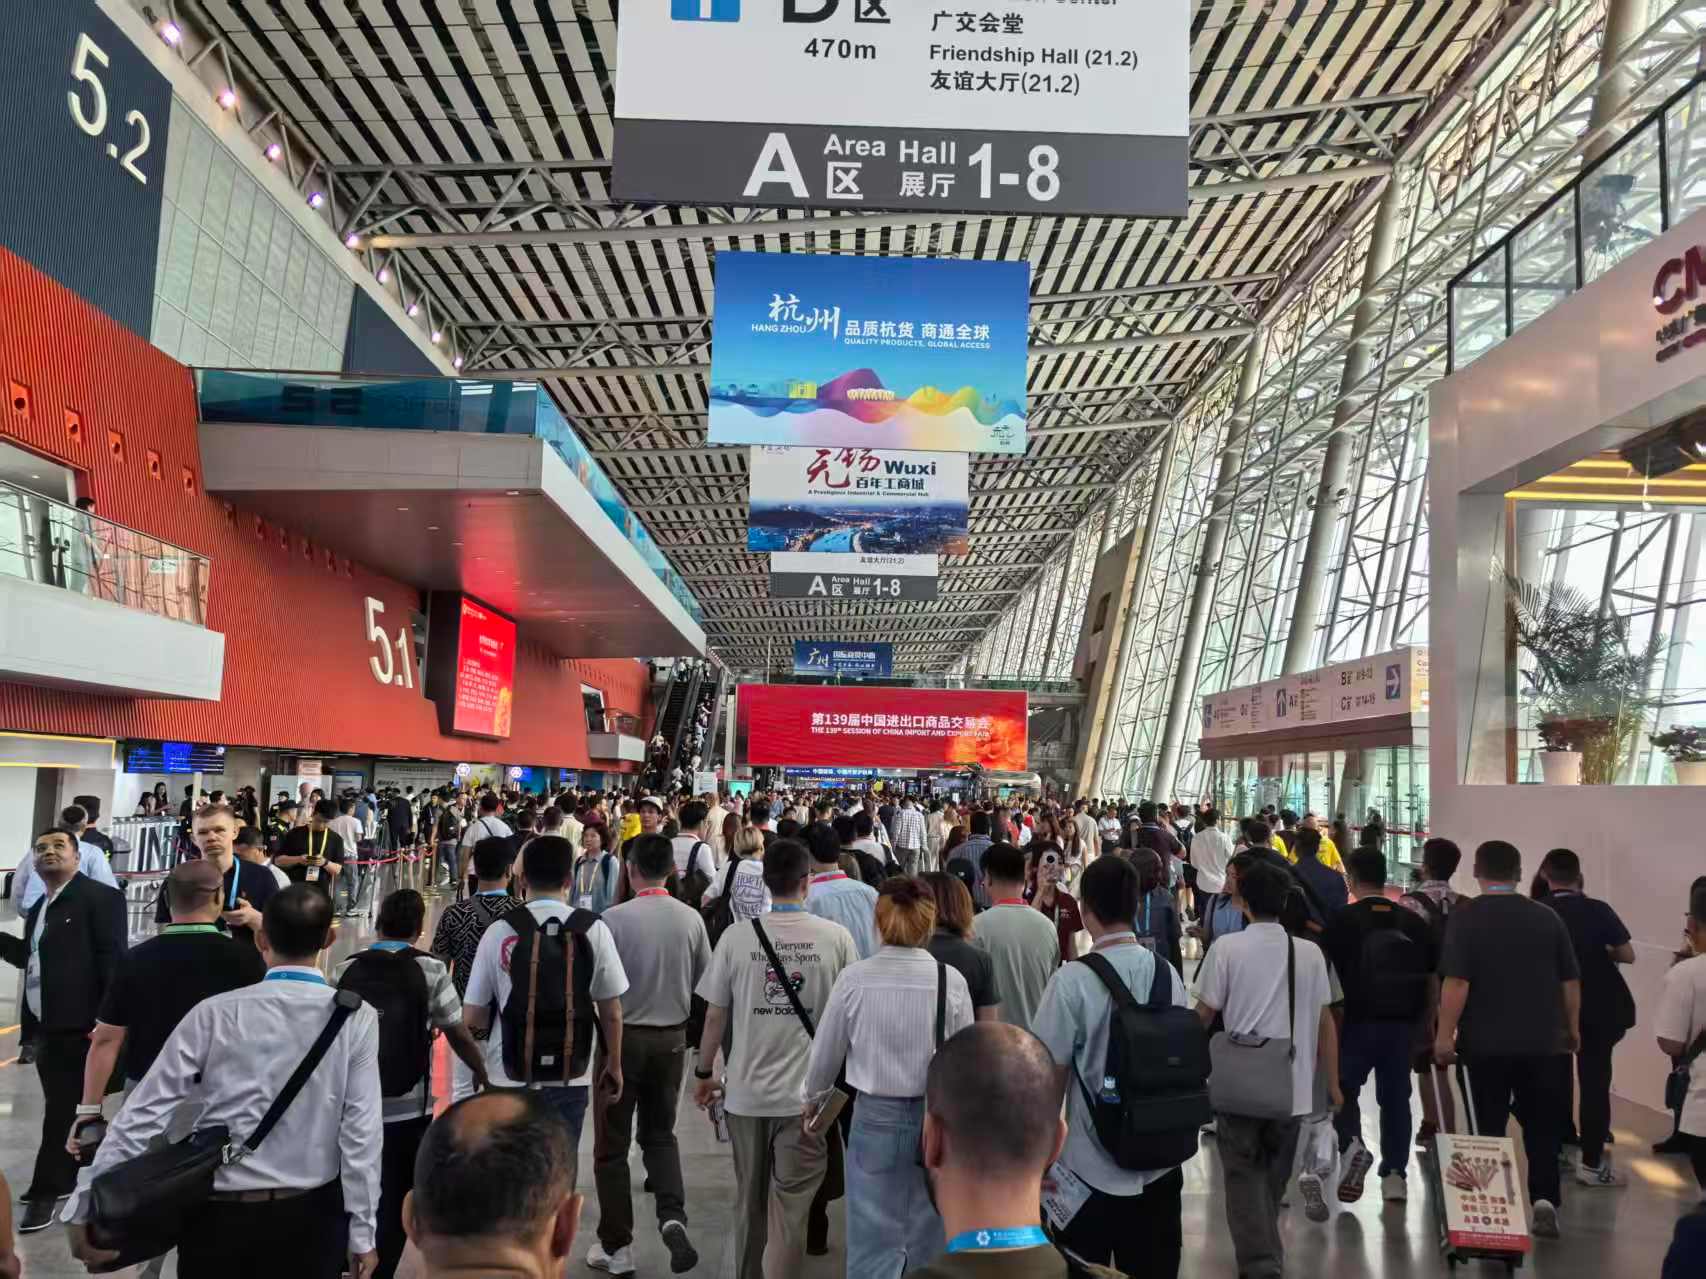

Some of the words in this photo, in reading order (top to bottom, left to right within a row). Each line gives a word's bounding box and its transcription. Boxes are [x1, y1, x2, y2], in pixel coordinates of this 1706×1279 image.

[931, 11, 1024, 34] 广交会堂
[804, 38, 876, 59] 470m
[930, 45, 1035, 67] Friendship
[1041, 48, 1078, 64] Hall
[1085, 50, 1138, 70] (21.2)
[930, 69, 1080, 96] 友谊大厅(21.2)
[67, 32, 150, 185] 5.2
[742, 132, 810, 198] A
[823, 133, 887, 156] Area
[899, 140, 956, 165] Hall
[968, 143, 1060, 201] 1-8
[826, 161, 863, 200] 区
[898, 171, 956, 198] 展厅
[768, 293, 841, 339] 杭州
[751, 323, 779, 334] HANG
[780, 324, 807, 335] ZHOU
[844, 320, 914, 338] 品质杭货
[921, 323, 990, 341] 商通全球
[884, 460, 936, 476] Wuxi
[856, 477, 925, 490] 百年工商城
[808, 575, 828, 596] A
[853, 577, 871, 585] Hall
[873, 578, 901, 597] 1-8
[365, 596, 414, 689] 5.1
[775, 941, 814, 952] Everyone
[794, 952, 821, 965] Sports
[753, 1007, 773, 1016] new
